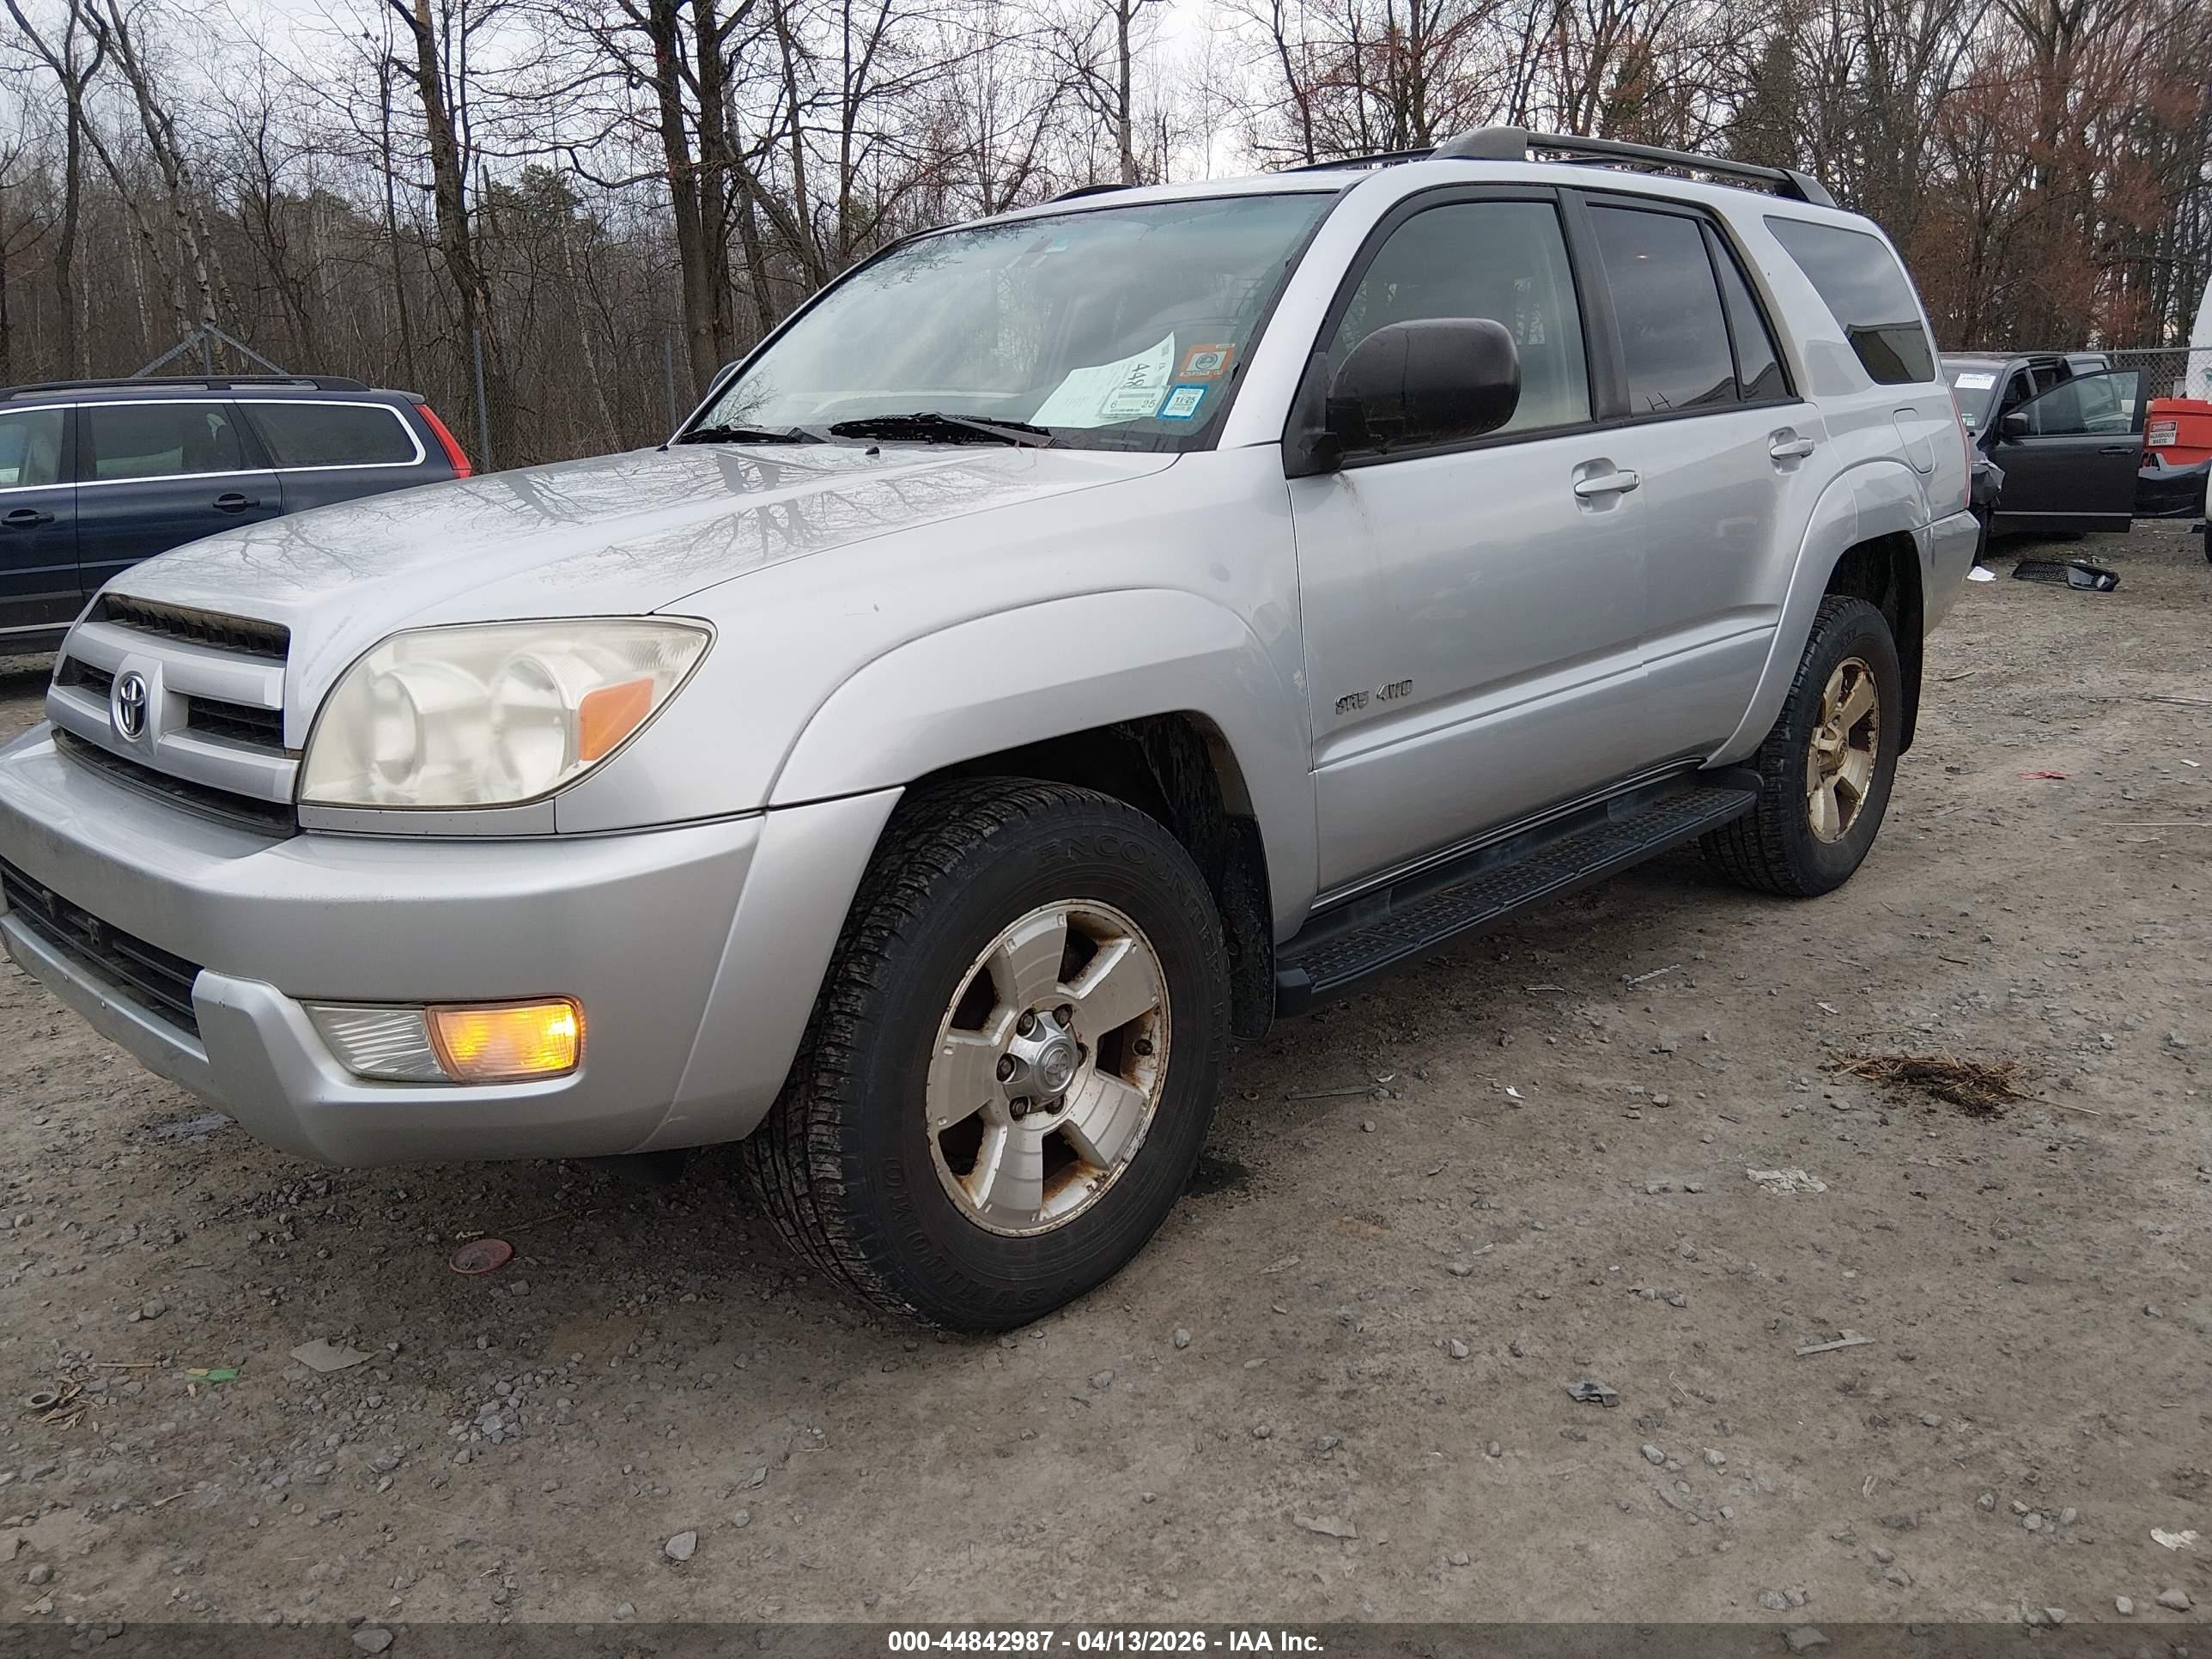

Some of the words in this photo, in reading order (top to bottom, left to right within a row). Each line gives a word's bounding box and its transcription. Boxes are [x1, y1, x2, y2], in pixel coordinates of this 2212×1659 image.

[1140, 399, 1156, 409] 25
[1334, 689, 1370, 715] SR5
[1376, 678, 1413, 702] 4WD
